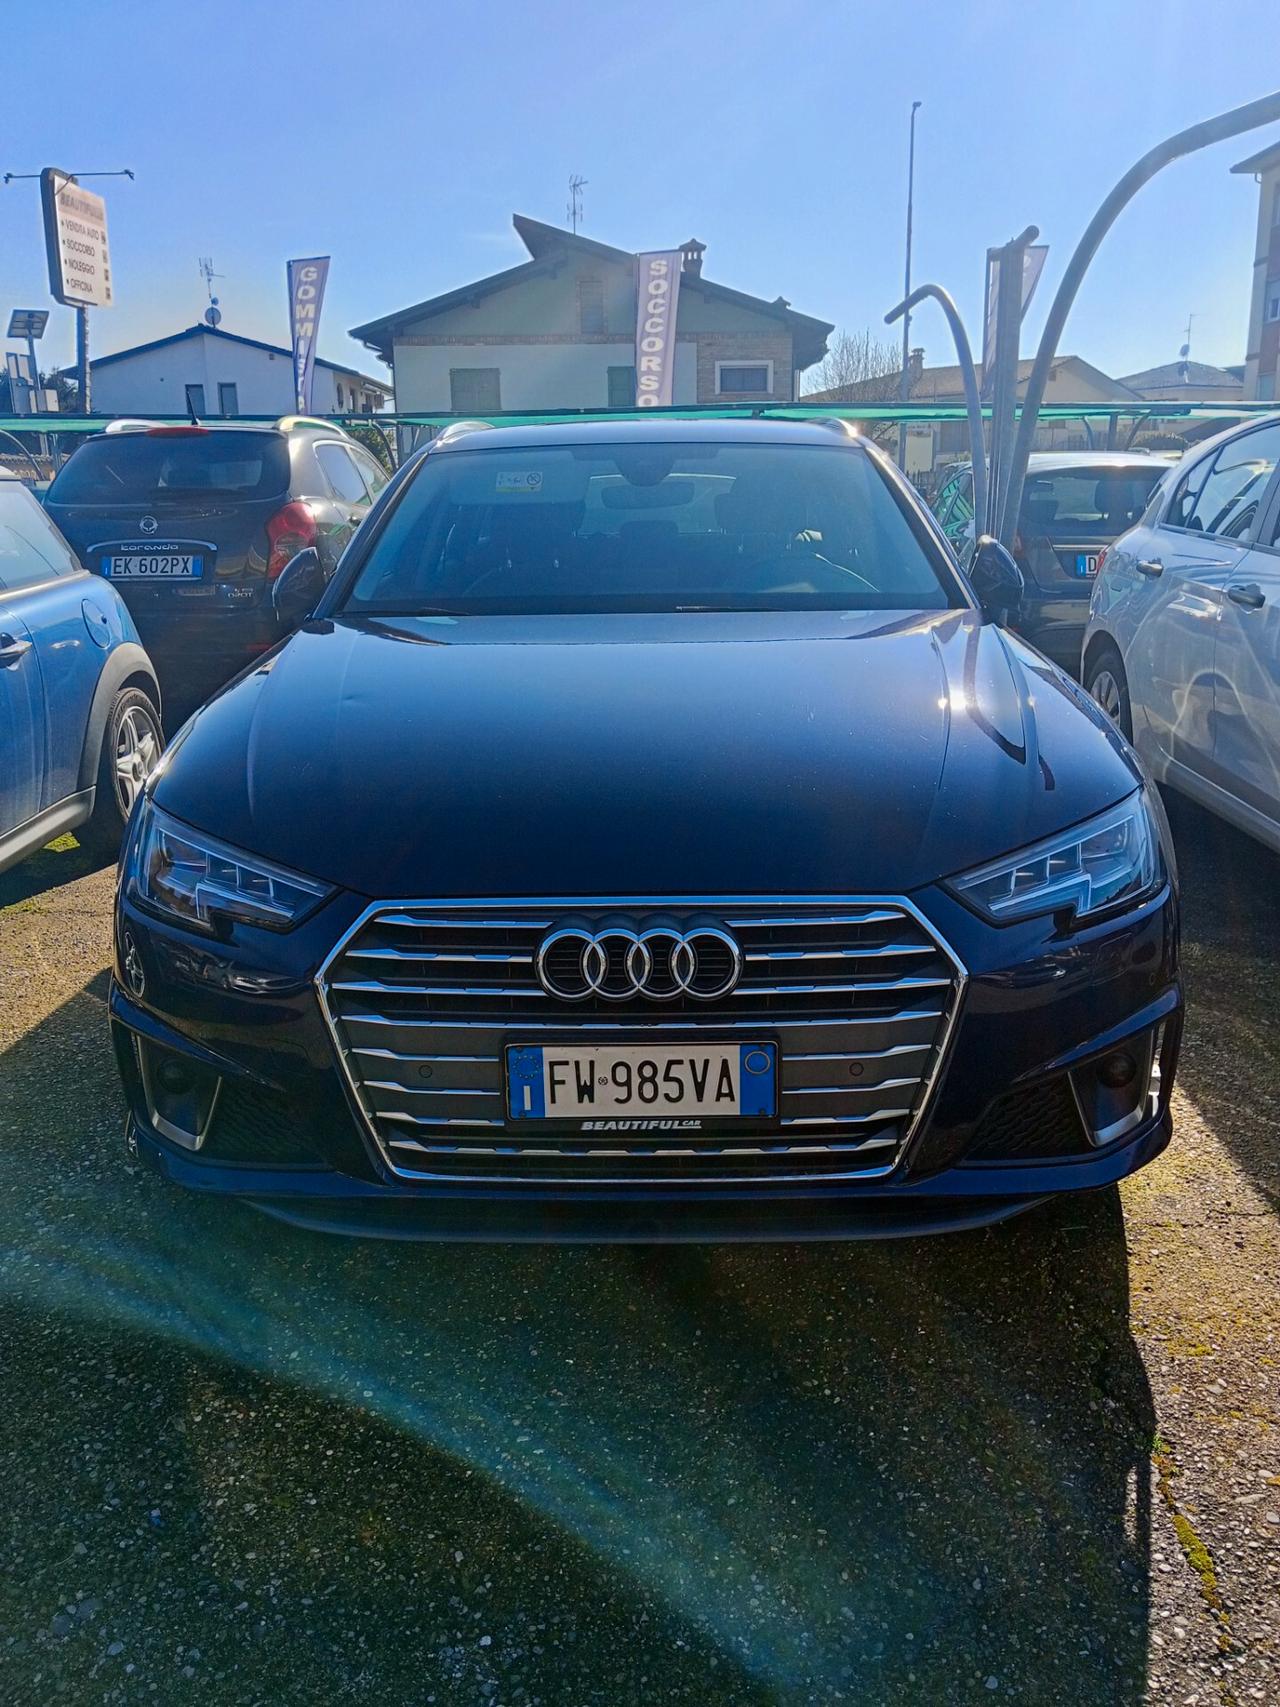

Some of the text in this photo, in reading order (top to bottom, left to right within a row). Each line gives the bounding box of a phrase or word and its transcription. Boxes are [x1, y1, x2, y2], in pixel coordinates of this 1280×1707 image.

[87, 227, 99, 240] AUTO
[66, 238, 95, 256] SOCCORSO
[68, 258, 95, 275] NOLEGGIO
[70, 278, 93, 293] OFFICINA
[638, 260, 668, 407] SOCCORSO
[113, 557, 133, 575] EK
[138, 556, 191, 575] 602PX
[548, 1059, 596, 1105] FW
[611, 1058, 736, 1105] 985VA
[580, 1120, 681, 1131] BEAUTIFUL
